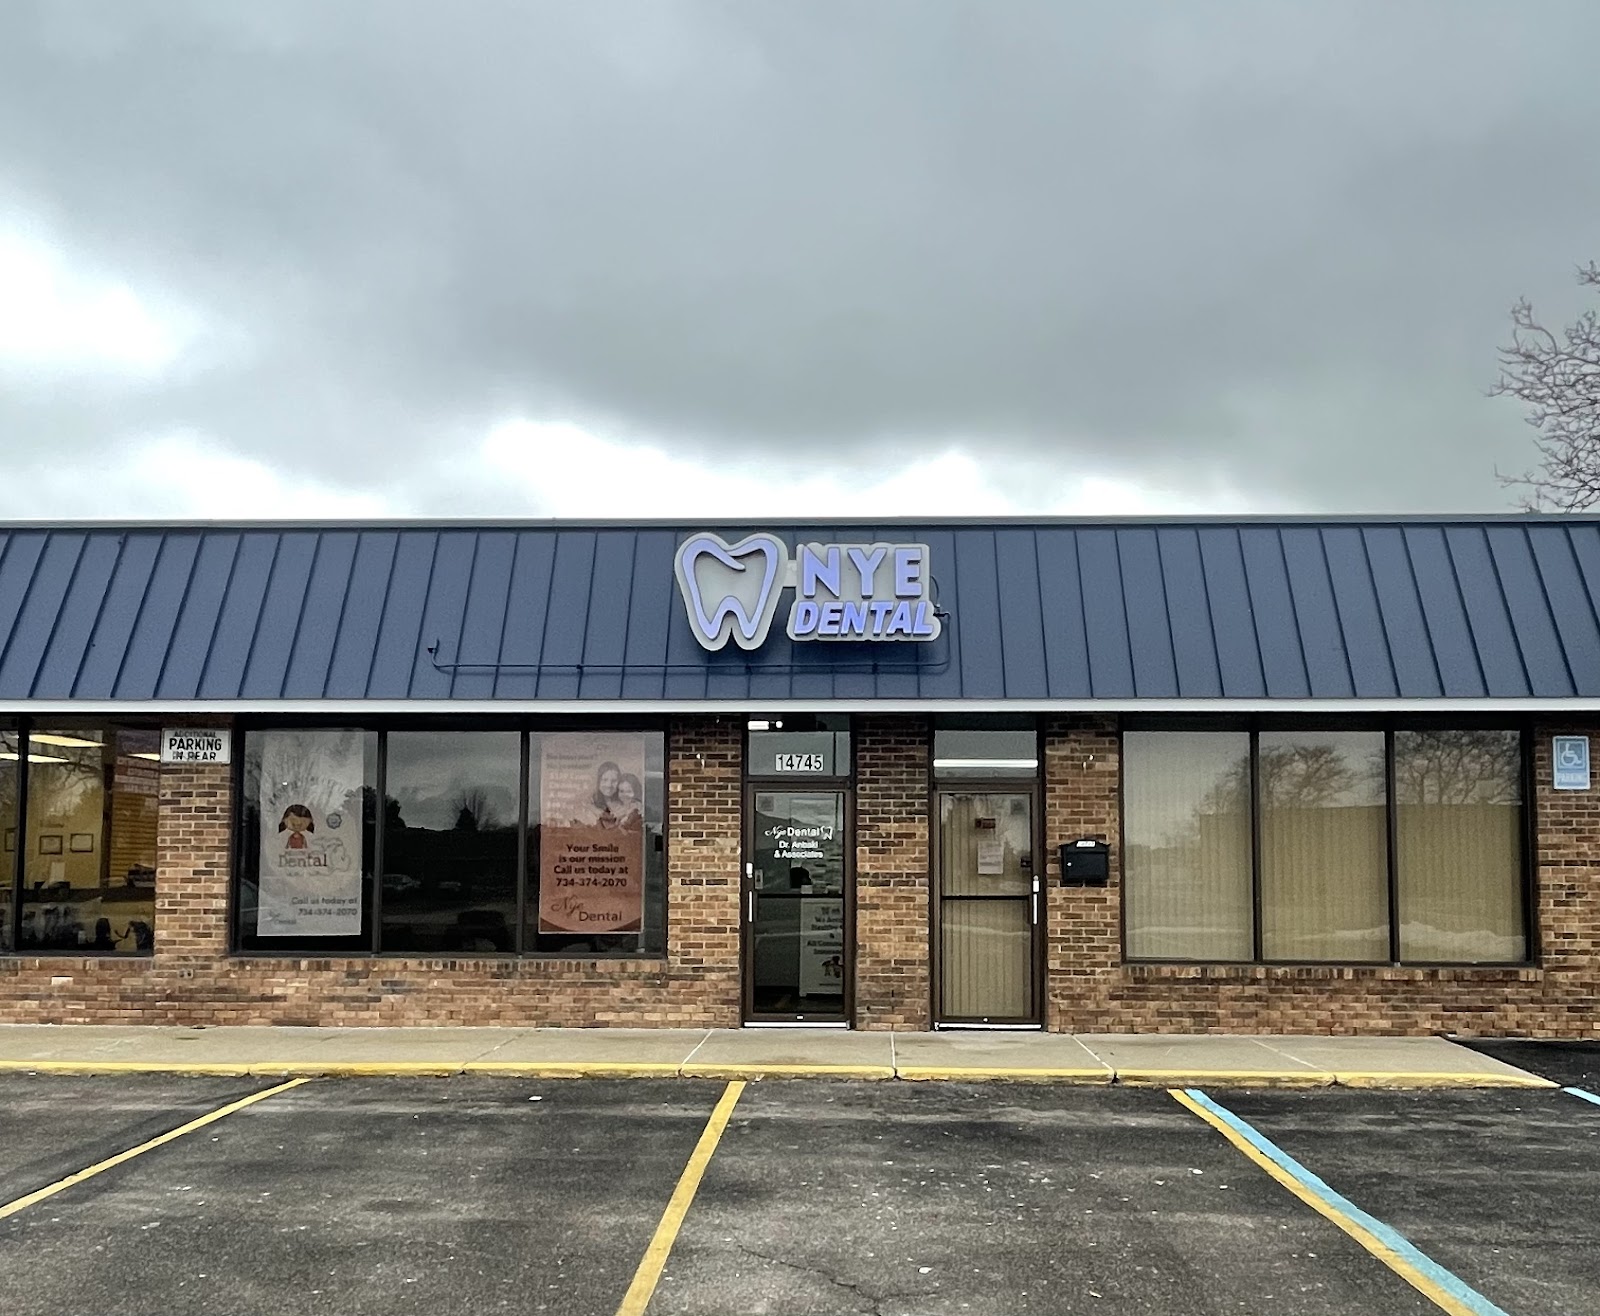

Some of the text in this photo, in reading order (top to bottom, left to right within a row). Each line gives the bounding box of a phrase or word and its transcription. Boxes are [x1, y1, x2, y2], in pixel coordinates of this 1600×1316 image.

[802, 546, 922, 598] NYE
[794, 601, 934, 635] DENTAL
[169, 738, 222, 751] PARKING
[172, 751, 217, 761] IN REAR
[777, 754, 823, 770] 14745
[787, 826, 820, 837] Dental
[566, 843, 619, 853] Your Smile
[588, 854, 626, 863] mission
[773, 850, 824, 859] & Associates
[278, 853, 328, 868] Dental
[554, 865, 629, 875] Call us today at
[556, 878, 627, 887] 734-374-2070
[322, 896, 346, 906] today
[579, 911, 622, 921] Dental
